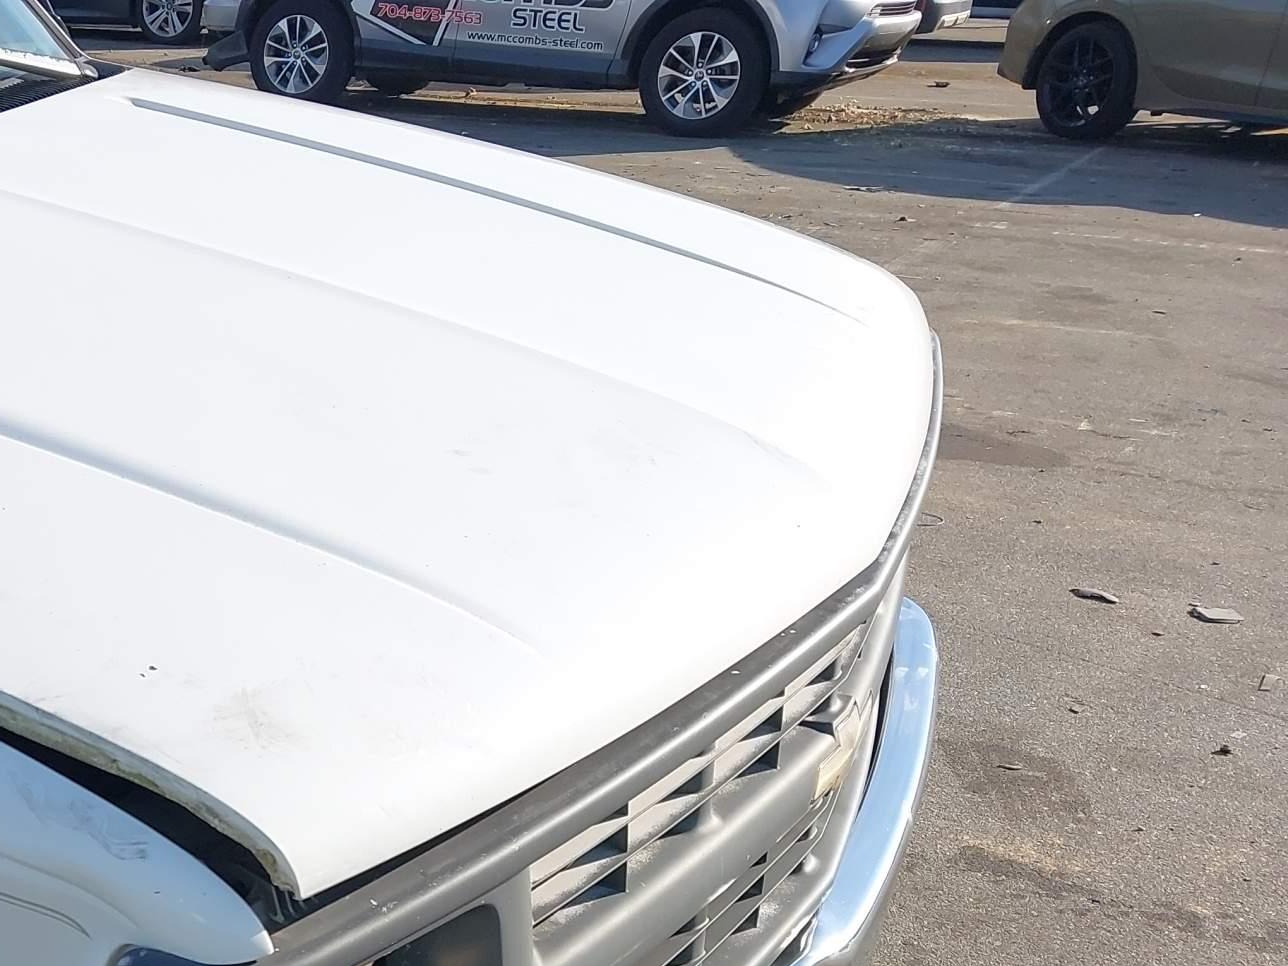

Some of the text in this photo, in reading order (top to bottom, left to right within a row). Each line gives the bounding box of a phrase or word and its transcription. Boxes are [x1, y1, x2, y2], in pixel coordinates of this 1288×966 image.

[377, 3, 483, 25] 704-873-7563
[511, 7, 585, 32] STEEL
[467, 31, 603, 51] www.mccombs-steel.com
